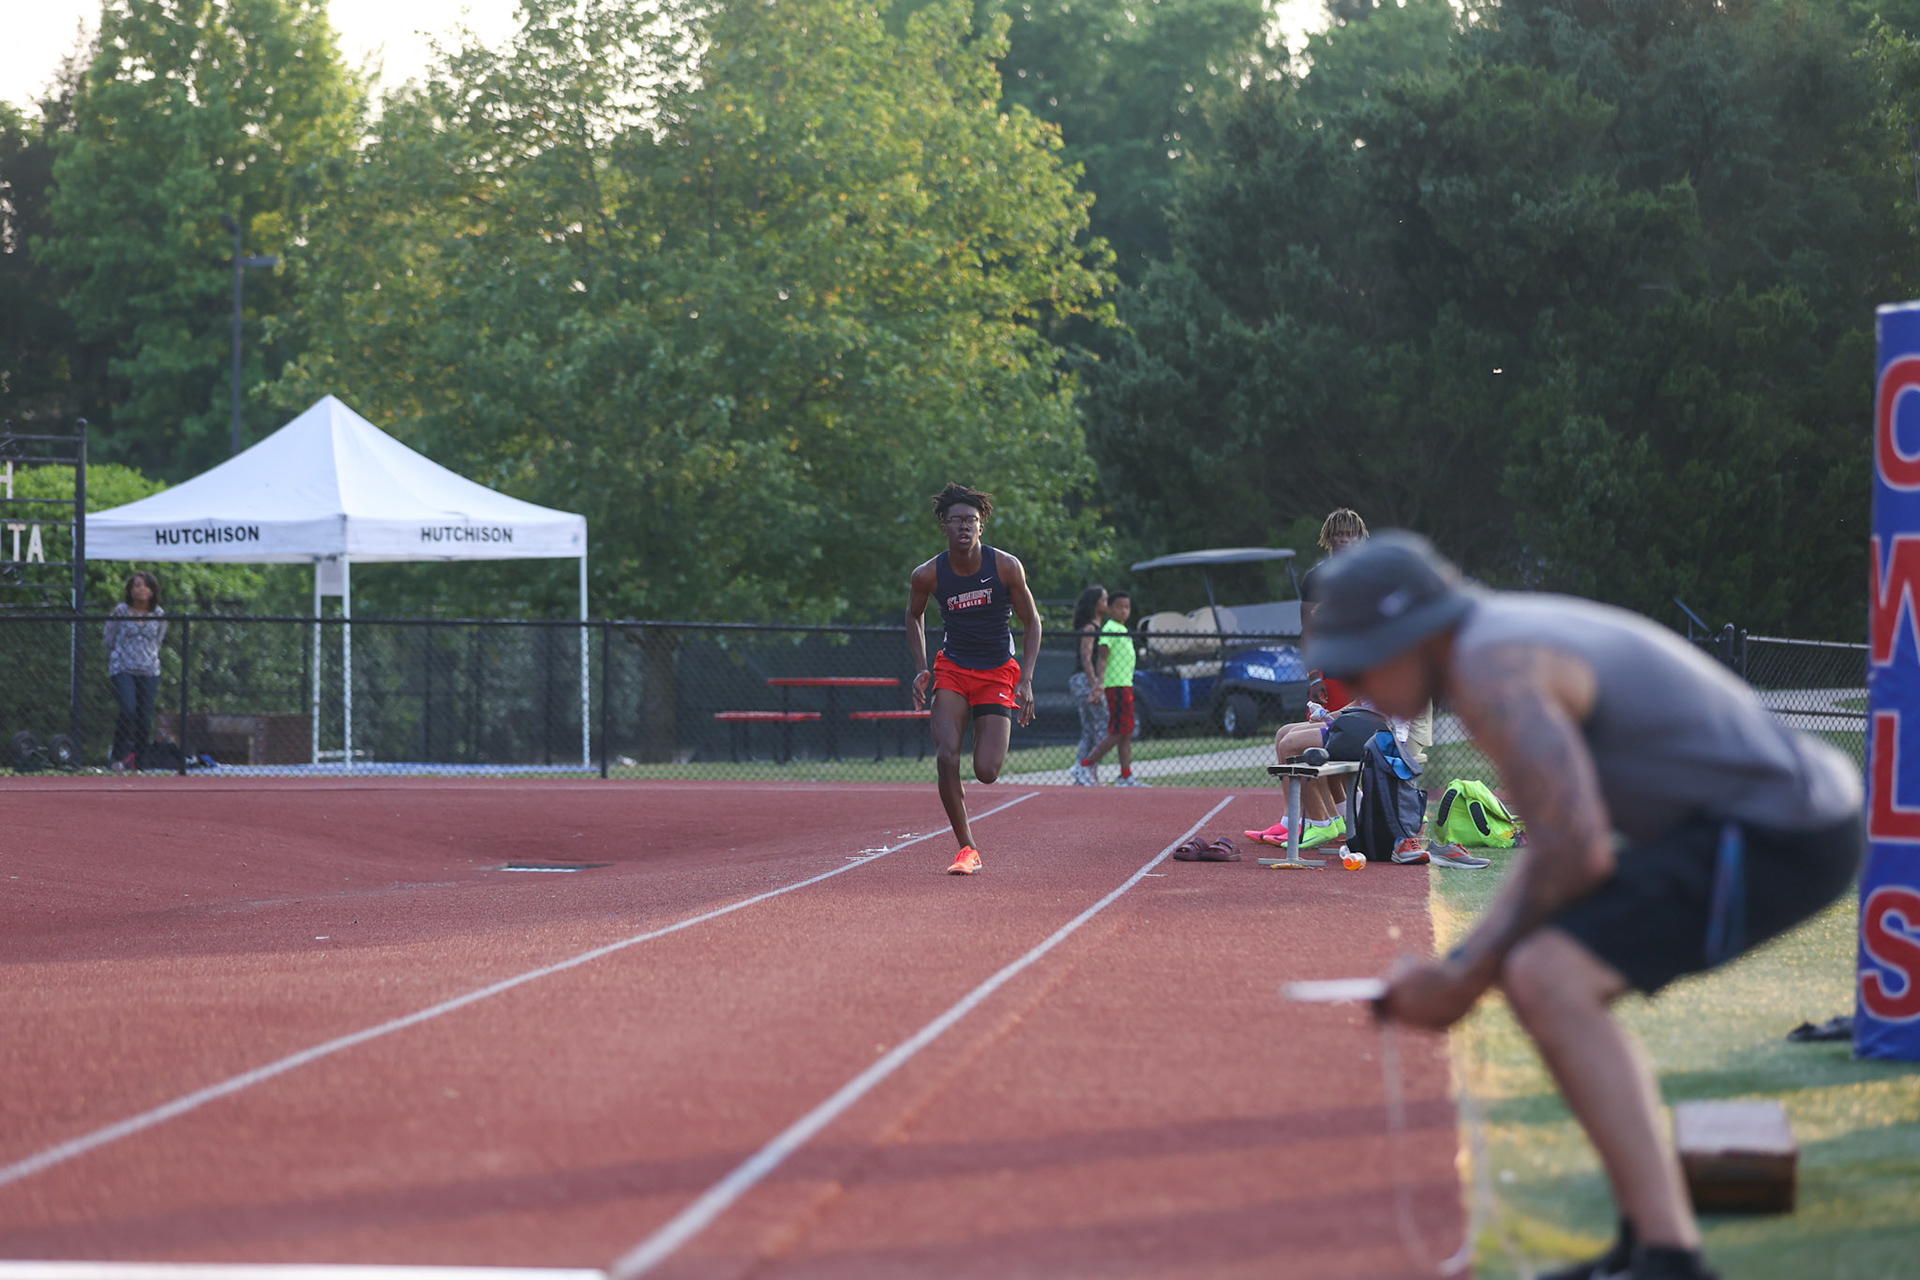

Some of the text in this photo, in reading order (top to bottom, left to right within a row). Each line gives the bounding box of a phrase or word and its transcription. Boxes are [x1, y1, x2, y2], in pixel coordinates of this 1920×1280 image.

[0, 523, 45, 563] TA
[156, 526, 259, 545] HUTCHISON
[421, 527, 513, 543] HUTCHISON
[958, 599, 982, 609] EAGLES
